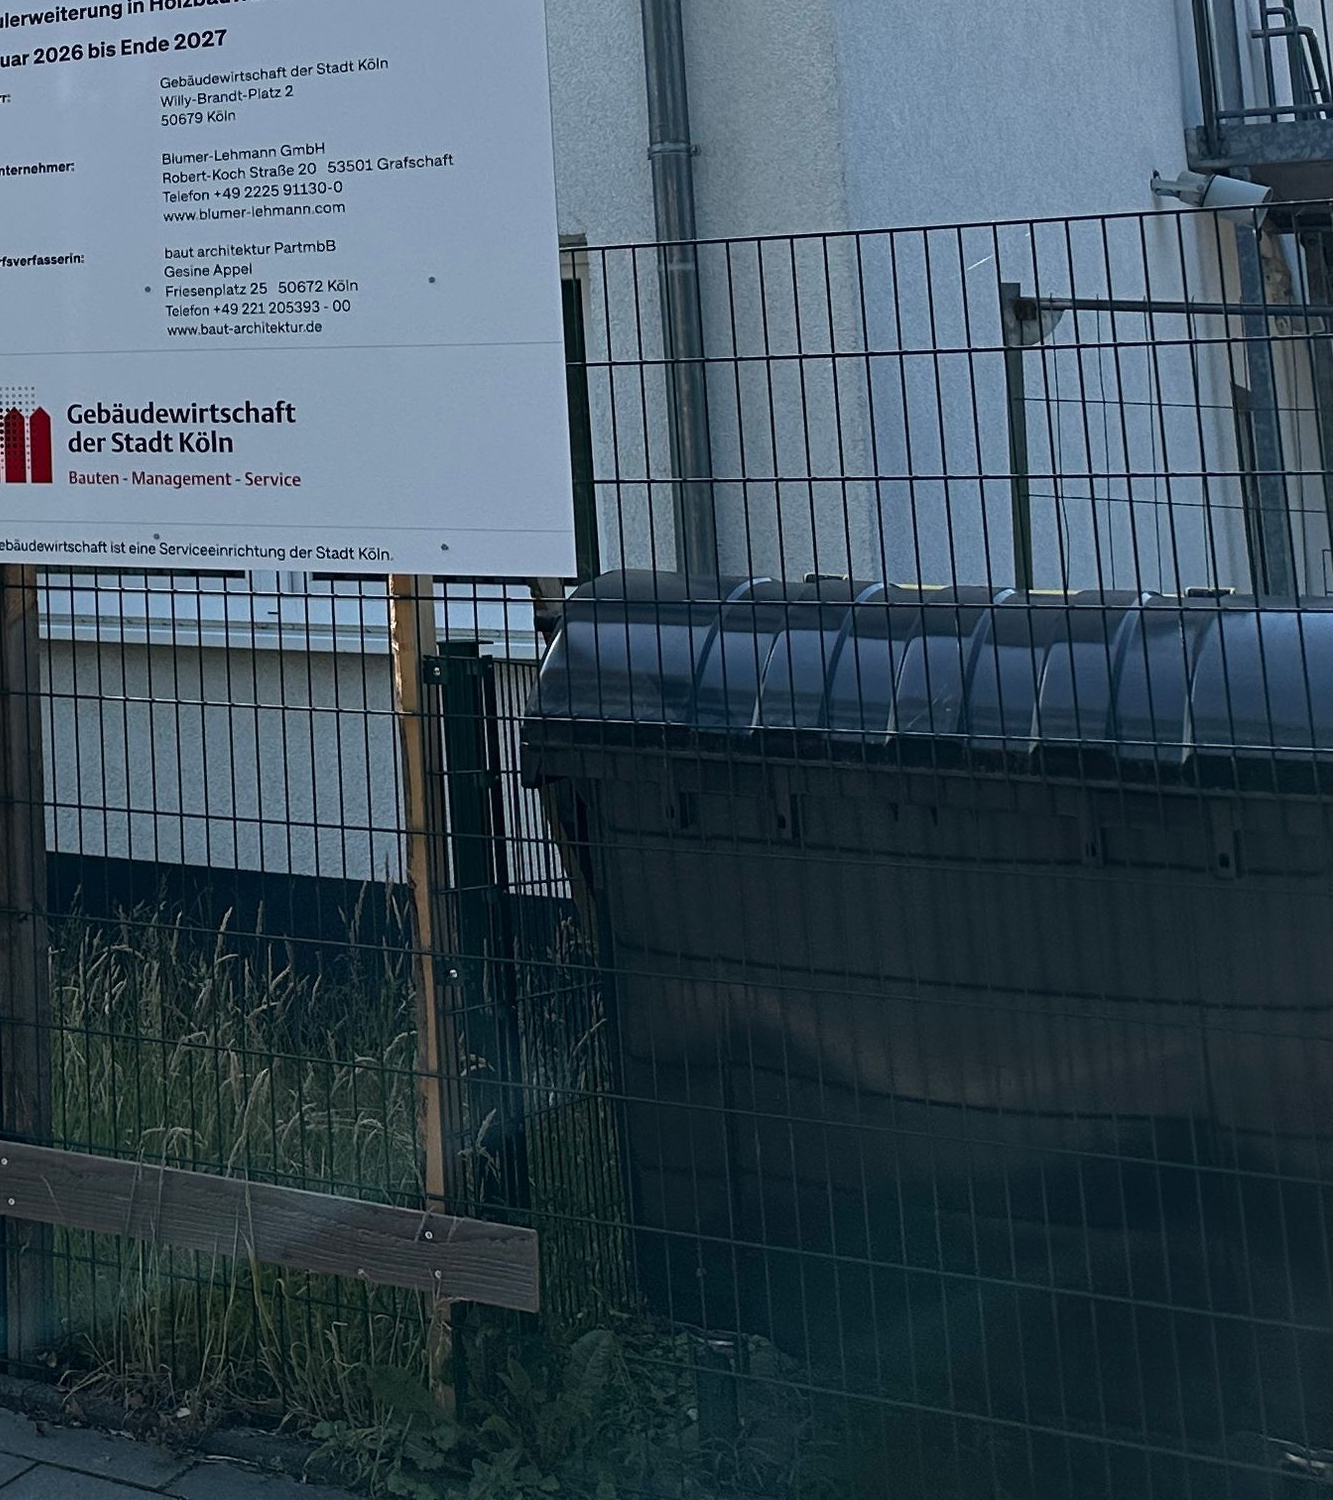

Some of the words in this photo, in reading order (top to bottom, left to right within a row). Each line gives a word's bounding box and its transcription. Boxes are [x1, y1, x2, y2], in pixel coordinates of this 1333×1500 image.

[33, 44, 84, 65] 2026
[88, 41, 116, 59] bis
[121, 36, 170, 56] Ende
[174, 29, 227, 50] 2027
[160, 66, 287, 89] Gebäudewirtschaft
[290, 65, 314, 77] der
[317, 60, 355, 75] Stadt
[358, 57, 388, 71] Köln
[160, 87, 282, 109] Willy-Brandt-Platz
[285, 85, 294, 97] 2
[161, 111, 203, 126] 50679
[207, 108, 236, 123] Köln
[162, 148, 277, 165] Blumer-Lehmann
[280, 142, 325, 157] GmbH
[163, 167, 246, 184] Robert-Koch
[249, 164, 295, 179] Straße
[298, 162, 317, 176] 20
[327, 158, 373, 174] 53501
[377, 153, 454, 170] Grafschaft
[162, 189, 210, 203] Telefon
[214, 187, 240, 200] +49
[244, 184, 279, 198] 2225
[283, 180, 343, 196] 91130-0
[163, 203, 346, 222] www.blumer-lehmann.com
[165, 247, 195, 259] baut
[197, 244, 271, 258] architektur
[274, 239, 336, 254] PartmbB
[164, 265, 210, 278] Gesine
[213, 262, 252, 278] Appel
[165, 283, 247, 299] Friesenplatz
[250, 282, 268, 295] 25
[278, 280, 324, 294] 50672
[327, 279, 358, 292] Köln
[165, 304, 210, 317] Telefon
[213, 303, 238, 315] +49
[242, 302, 266, 315] 221
[268, 300, 320, 314] 205393
[332, 299, 351, 312] 00
[167, 320, 322, 336] www.baut-architektur.de
[67, 400, 296, 424] Gebäudewirtschaft
[68, 430, 107, 453] der
[111, 430, 174, 453] Stadt
[179, 430, 233, 453] Köln
[69, 471, 119, 485] Bauten
[132, 471, 232, 489] Management
[245, 472, 301, 487] Service
[110, 541, 126, 554] ist
[129, 541, 156, 555] eine
[159, 542, 286, 561] Serviceeinrichtung
[289, 545, 313, 559] der
[316, 545, 355, 560] Stadt
